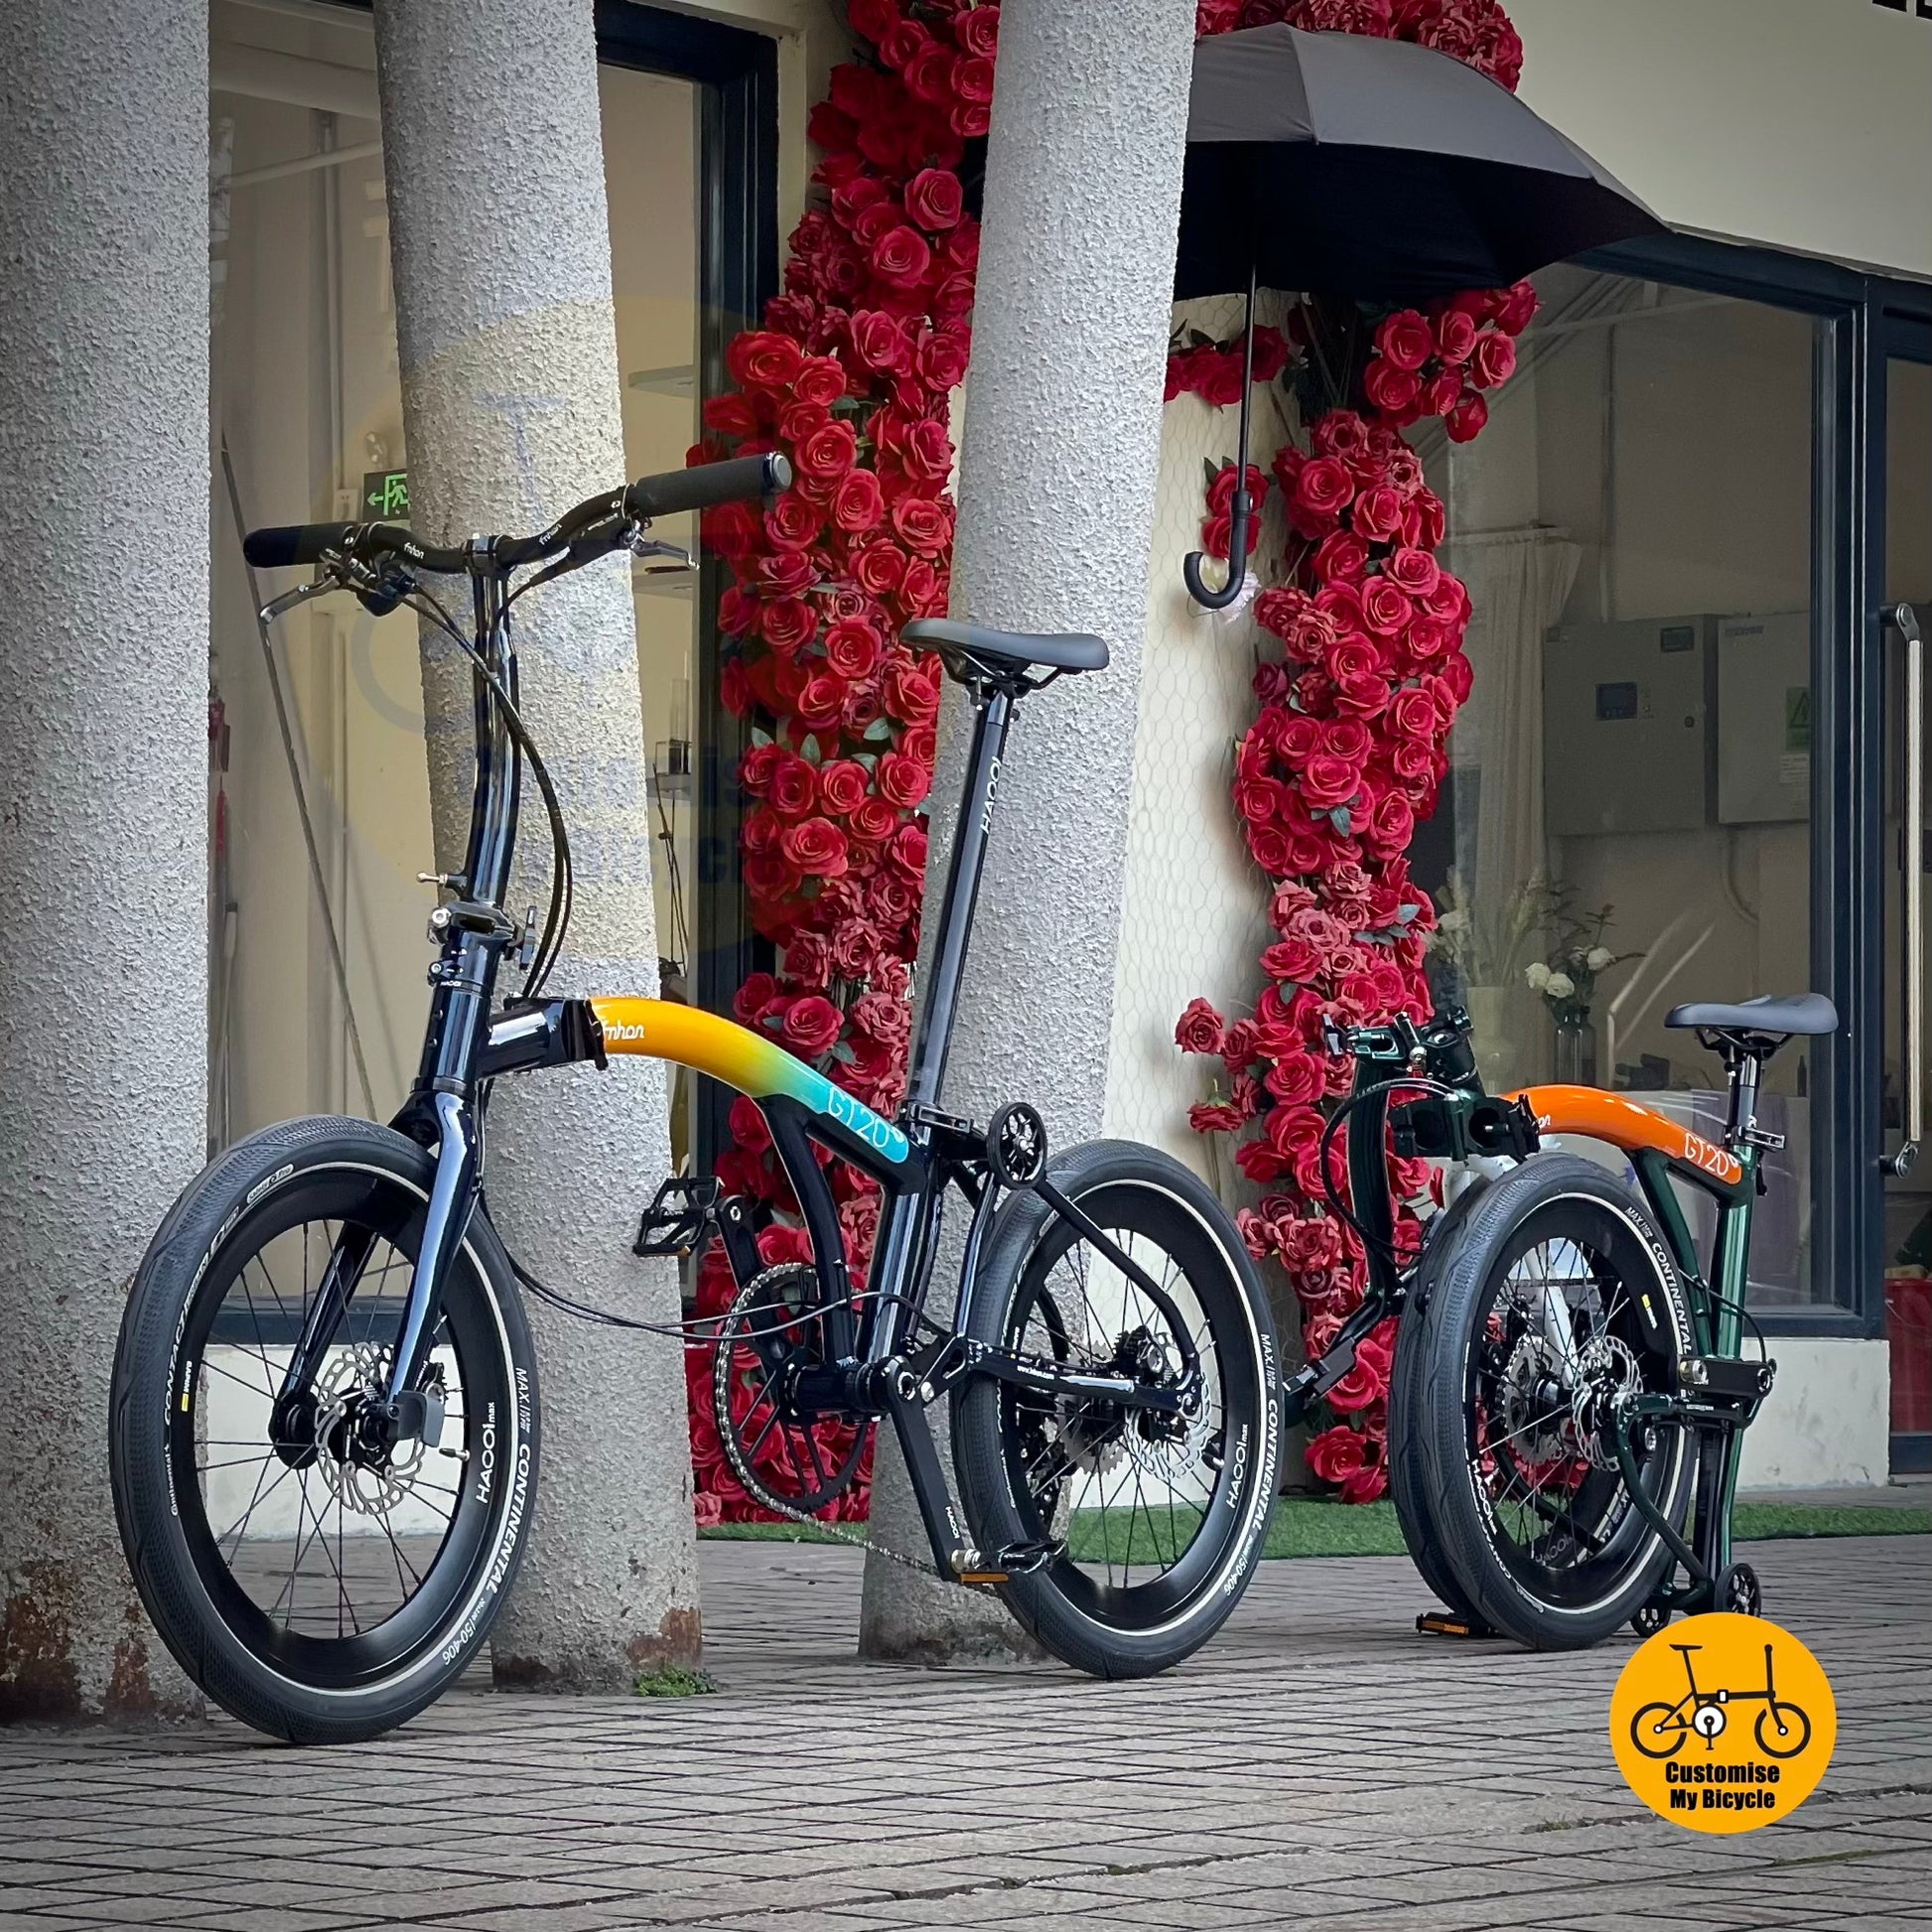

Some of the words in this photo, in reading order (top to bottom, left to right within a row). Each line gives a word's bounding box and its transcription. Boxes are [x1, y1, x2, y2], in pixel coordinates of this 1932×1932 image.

[1651, 1242, 1693, 1355] CONTINENTAL
[485, 1443, 531, 1593] CONTINENTAL
[1252, 1399, 1279, 1531] CONTINENTAL
